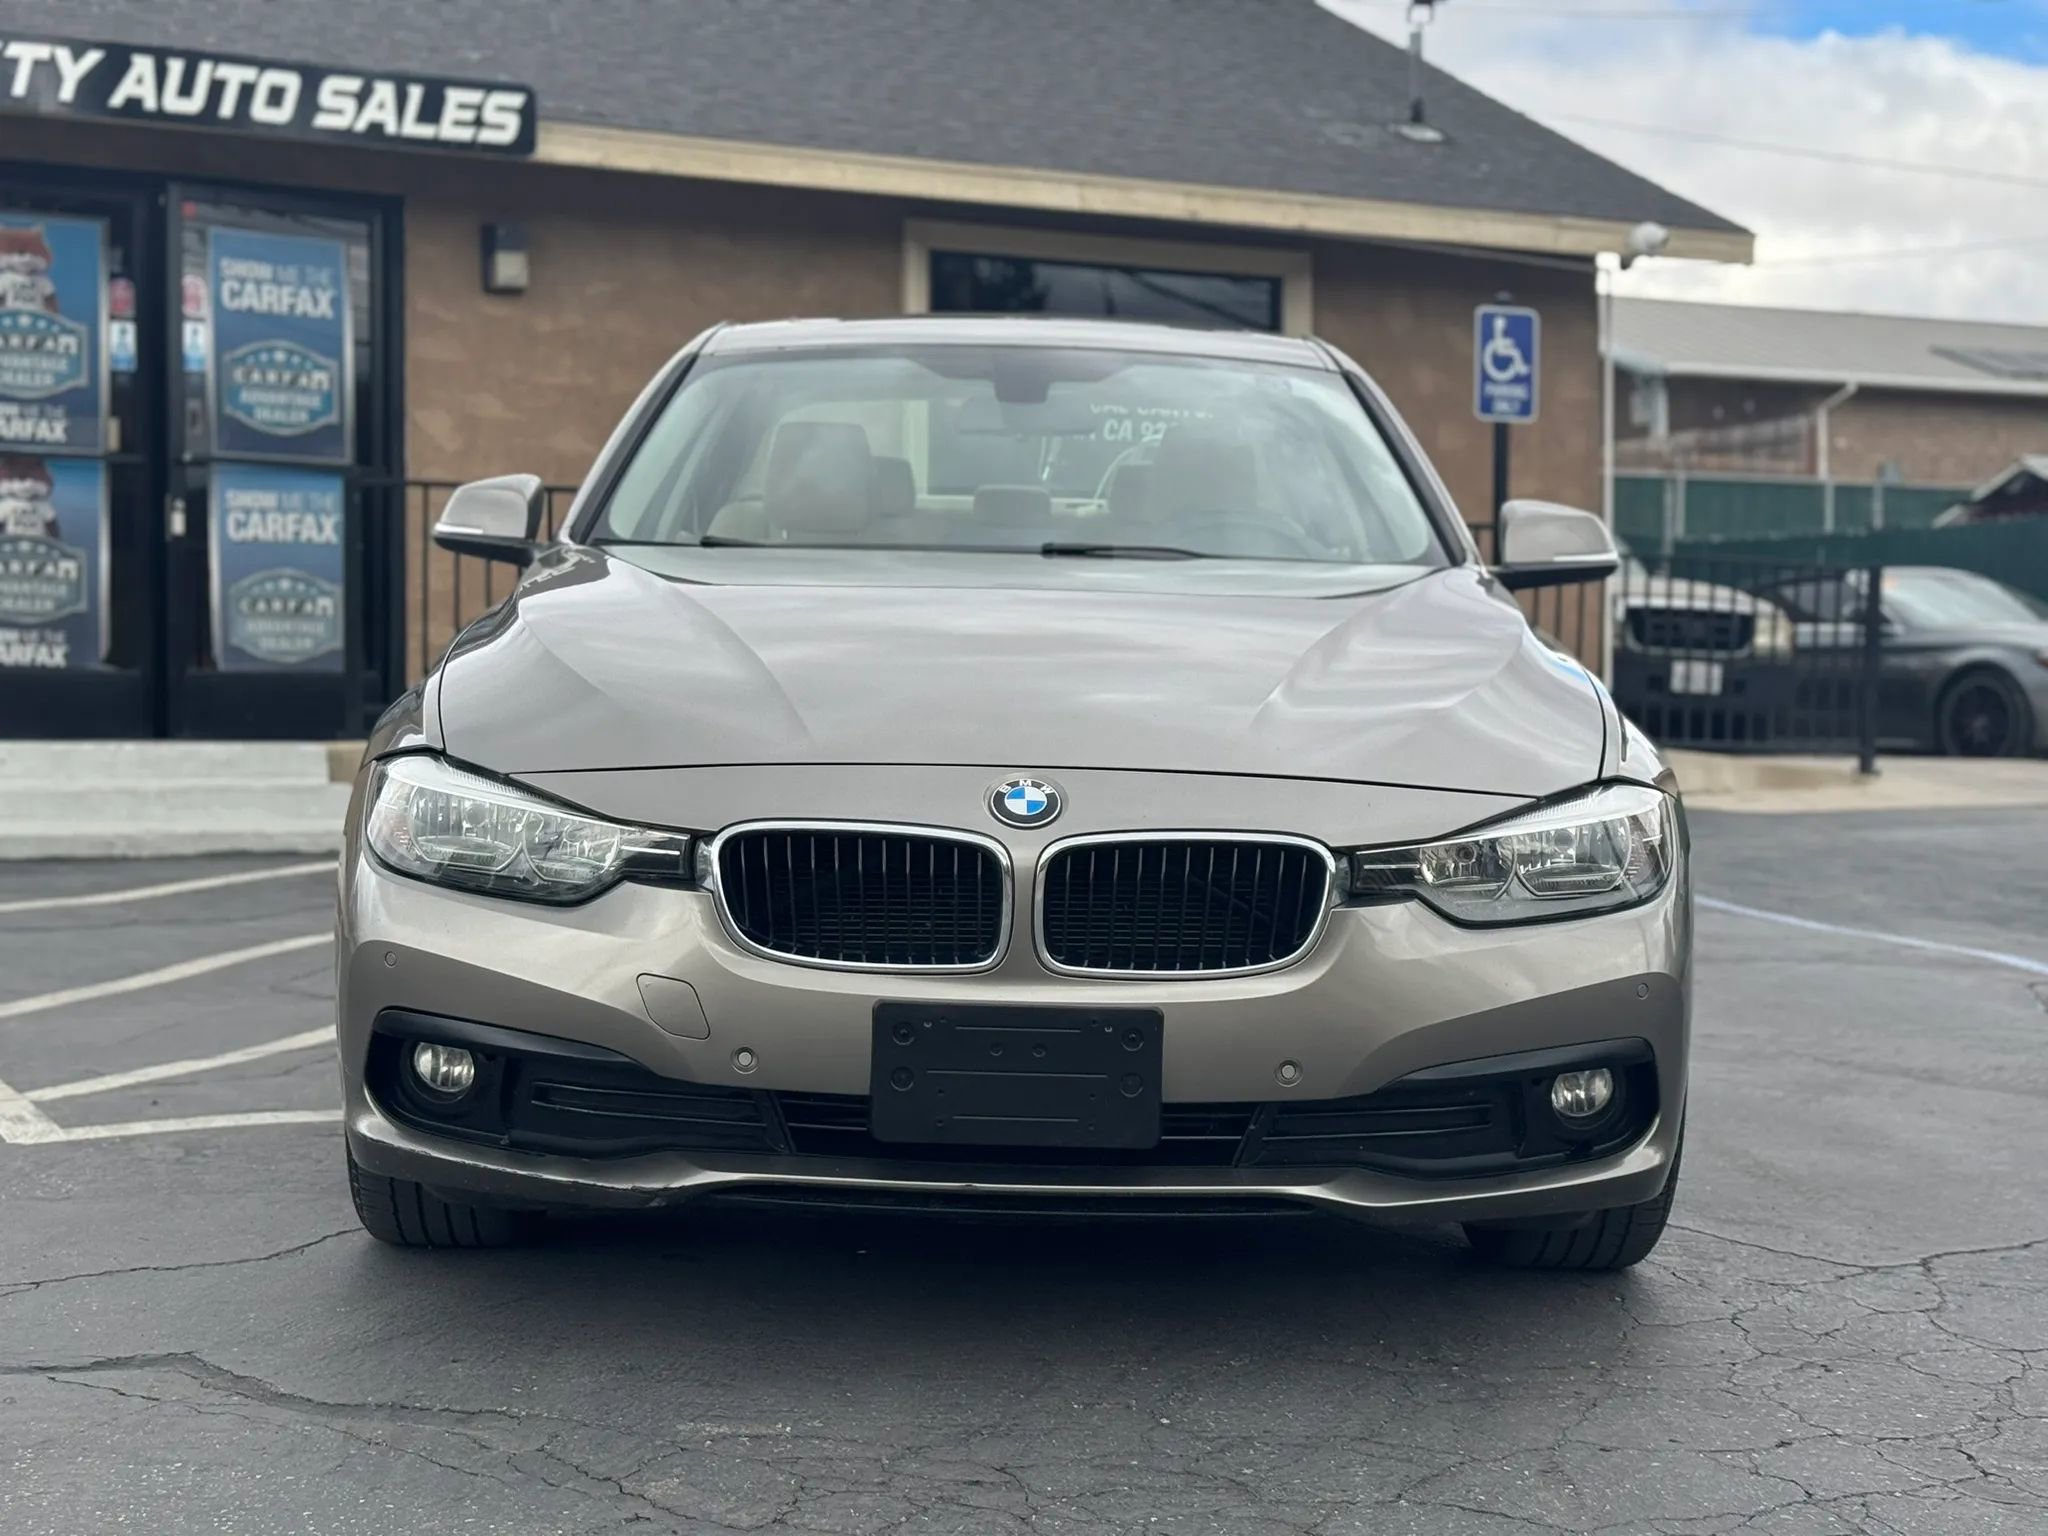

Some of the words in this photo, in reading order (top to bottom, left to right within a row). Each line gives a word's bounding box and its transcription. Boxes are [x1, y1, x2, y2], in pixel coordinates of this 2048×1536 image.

[0, 40, 107, 103] TY
[107, 53, 301, 125] AUTO
[311, 75, 527, 145] SALES
[221, 279, 339, 320] CARFAX
[227, 510, 340, 546] CARFAX
[998, 778, 1055, 795] BMW
